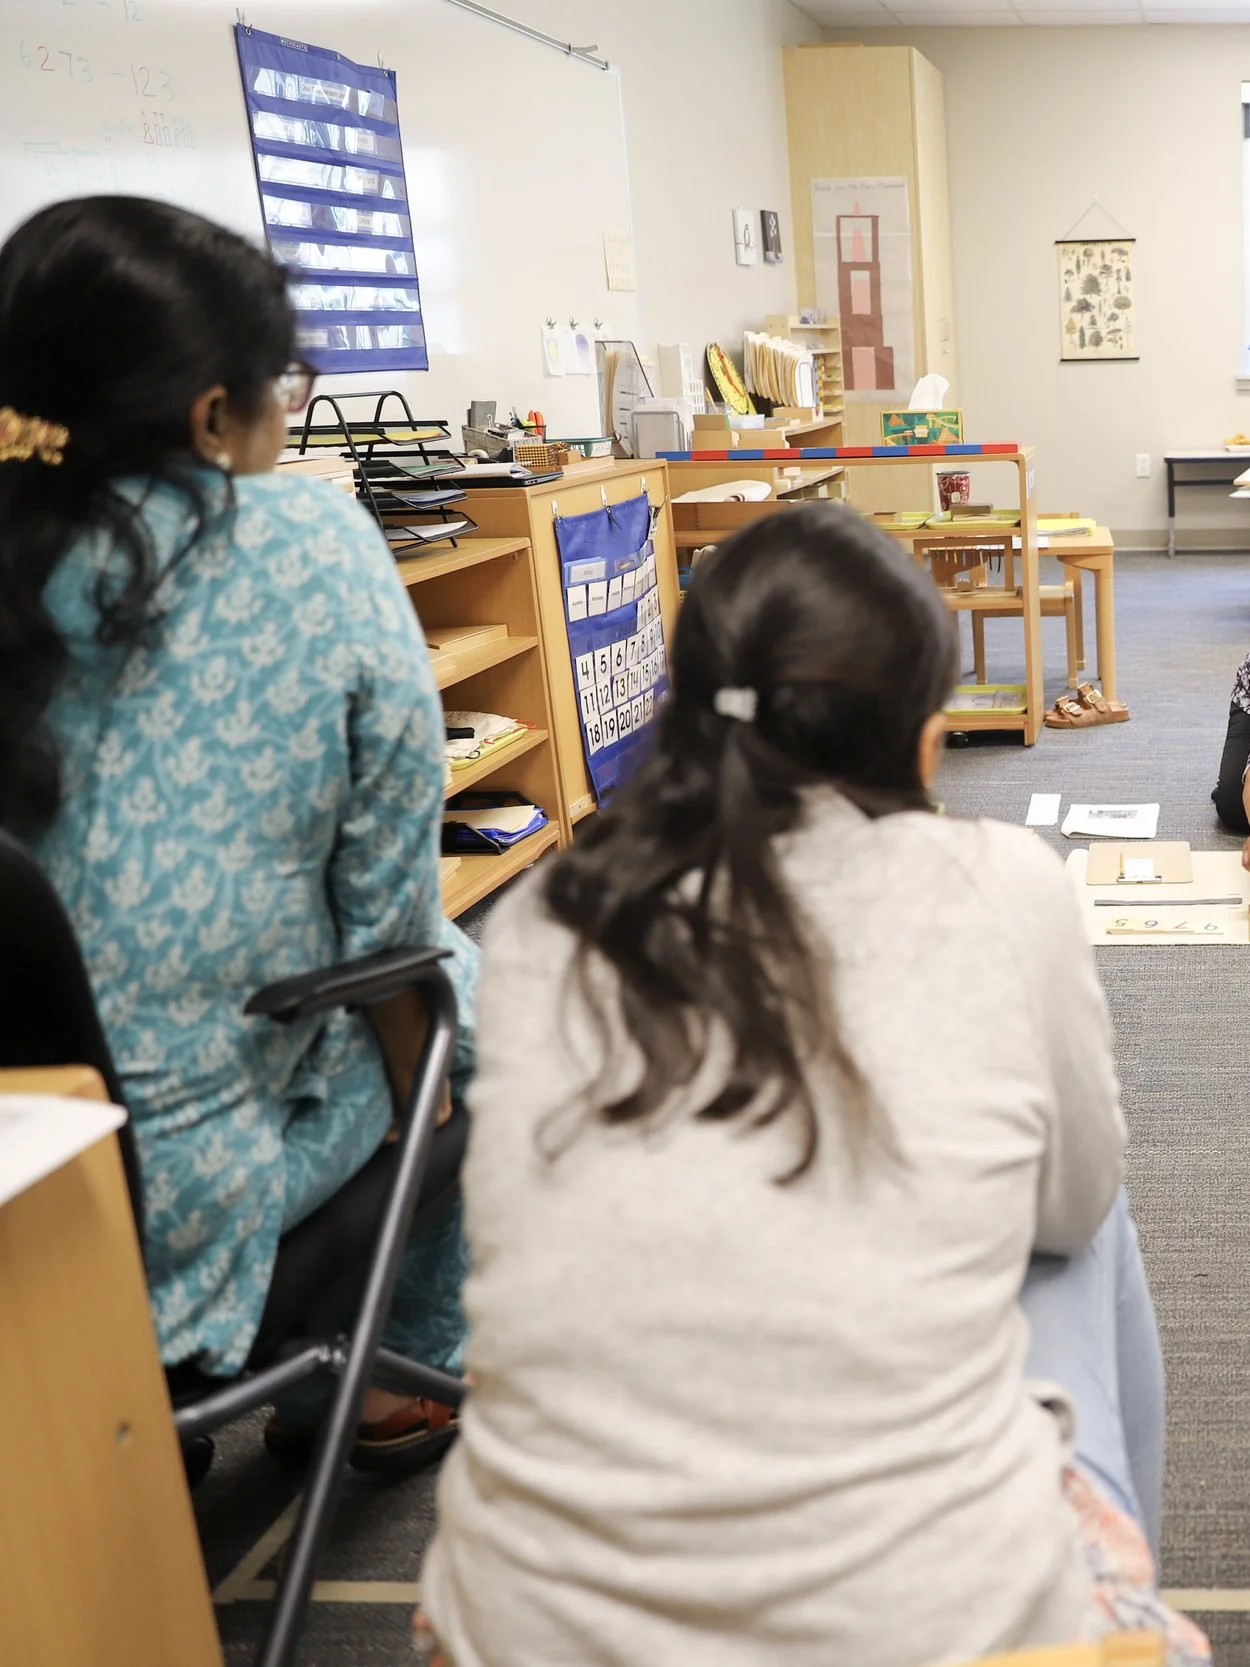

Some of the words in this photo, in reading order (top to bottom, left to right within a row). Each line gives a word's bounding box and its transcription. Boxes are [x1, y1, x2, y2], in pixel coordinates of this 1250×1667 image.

[647, 598, 652, 617] 2
[581, 660, 590, 680] 4
[600, 654, 607, 674] 5
[616, 647, 623, 667] 6
[630, 641, 636, 661] 7
[640, 634, 646, 652] 8
[649, 628, 655, 646] 9
[584, 692, 595, 715] 11
[599, 684, 611, 706] 12
[615, 677, 626, 698] 13
[630, 669, 639, 690] 14
[642, 663, 650, 682] 15
[651, 657, 658, 676] 16
[589, 723, 601, 747] 18
[604, 717, 615, 740] 19
[620, 709, 631, 732] 20
[633, 702, 643, 724] 21
[645, 695, 653, 717] 22
